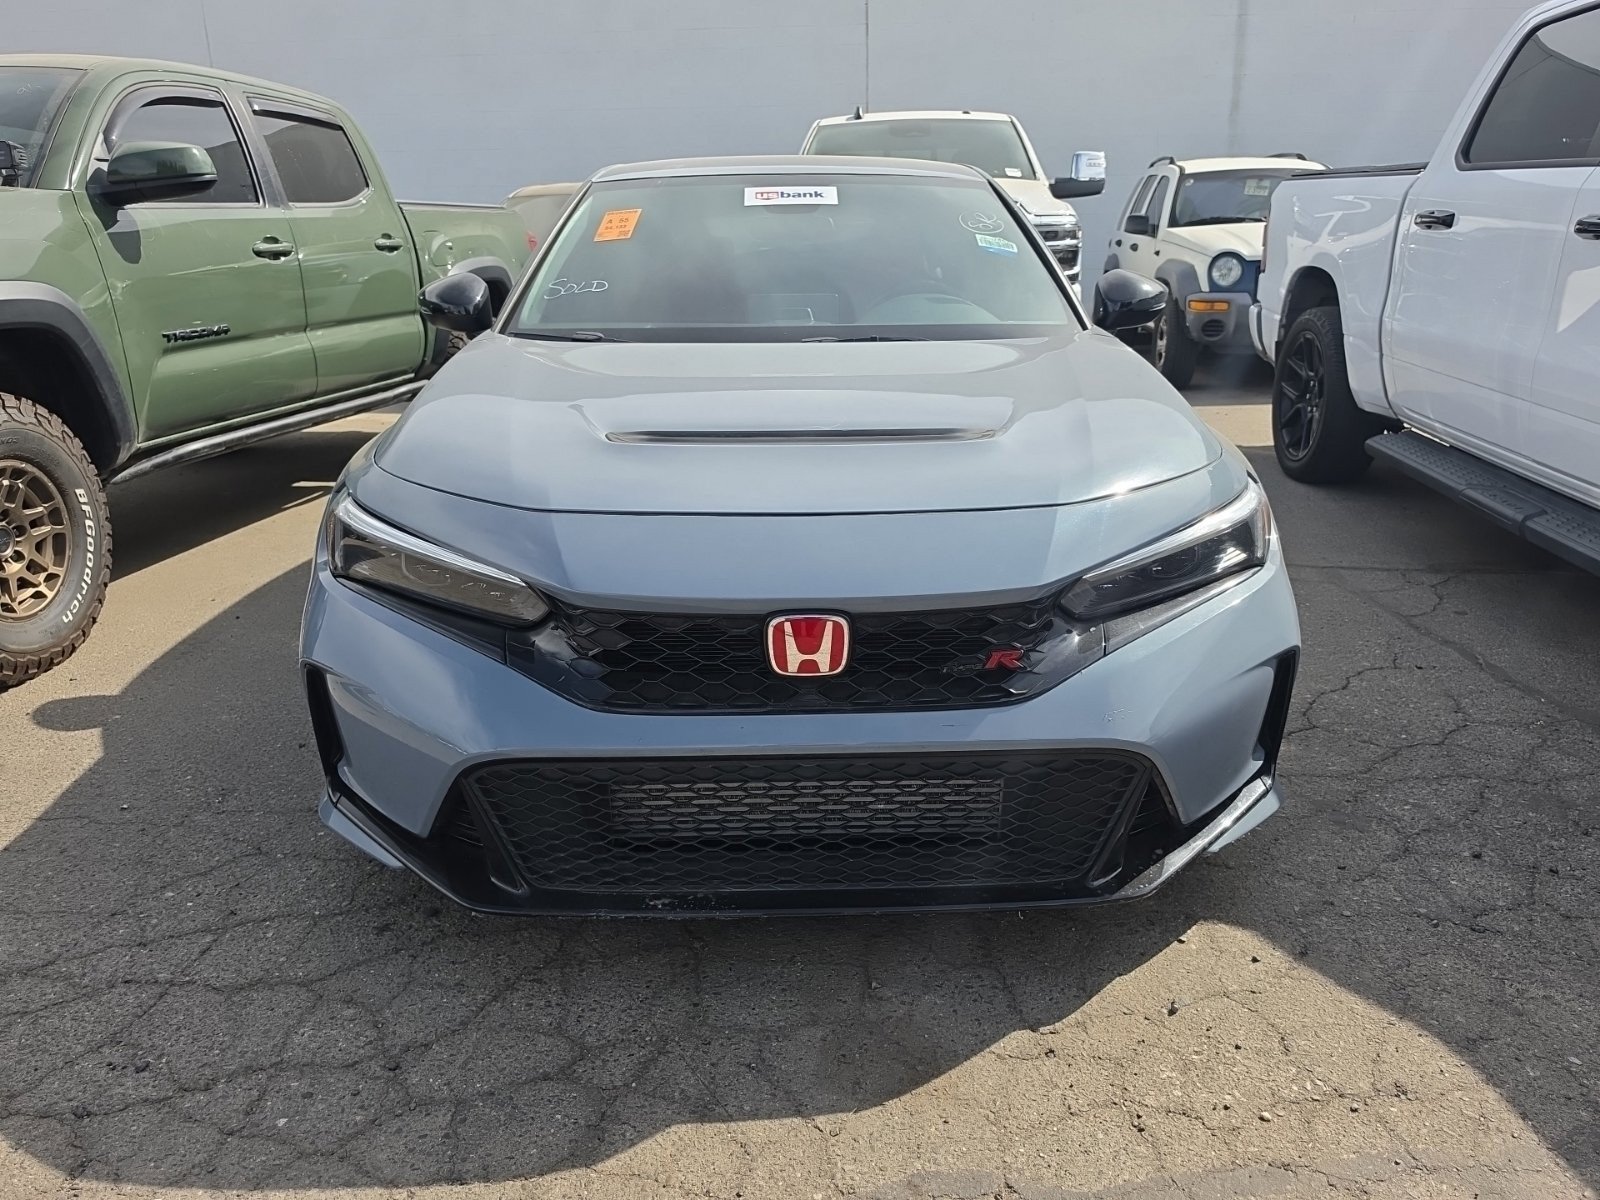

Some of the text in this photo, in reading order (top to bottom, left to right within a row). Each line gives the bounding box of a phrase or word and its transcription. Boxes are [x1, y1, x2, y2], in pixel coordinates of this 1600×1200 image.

[543, 278, 608, 299] SOLD
[162, 324, 231, 343] TACOMA
[62, 488, 96, 623] BFGoodrich
[984, 650, 1027, 671] R
